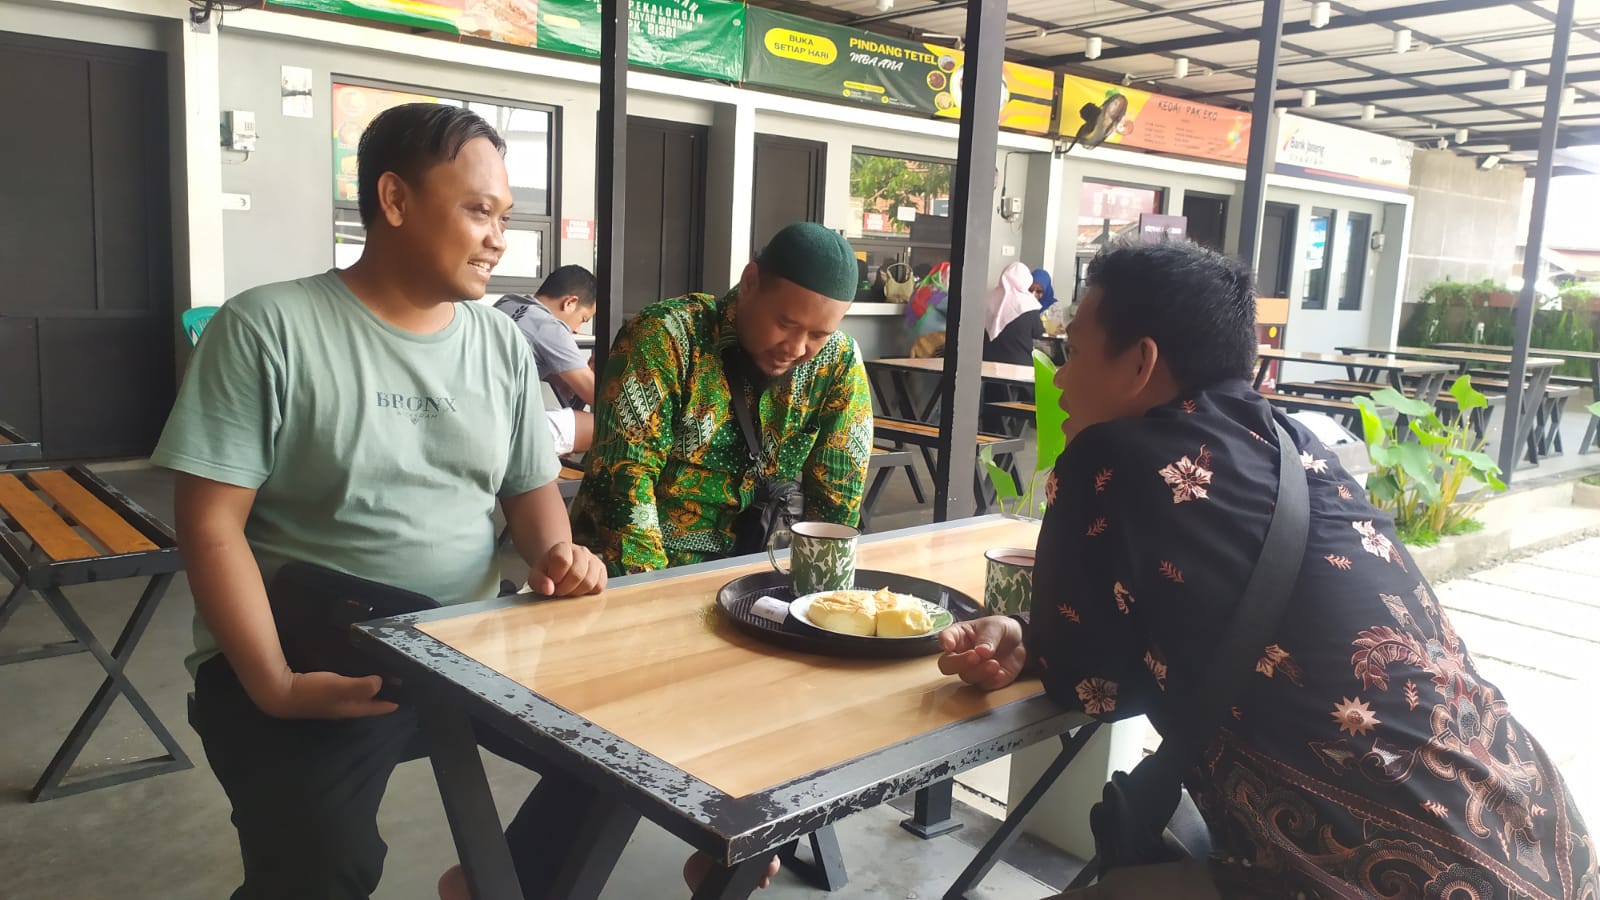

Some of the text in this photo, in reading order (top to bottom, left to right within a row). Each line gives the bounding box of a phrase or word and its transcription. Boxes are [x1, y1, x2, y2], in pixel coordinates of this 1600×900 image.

[628, 0, 704, 24] PEKALONGAN
[647, 23, 677, 39] BISRI
[788, 34, 814, 46] BUKA
[774, 42, 829, 60] SETIAP HARI
[849, 37, 938, 65] PINDANG TETEL
[1158, 101, 1180, 113] KEDAI
[376, 391, 456, 412] BRONX
